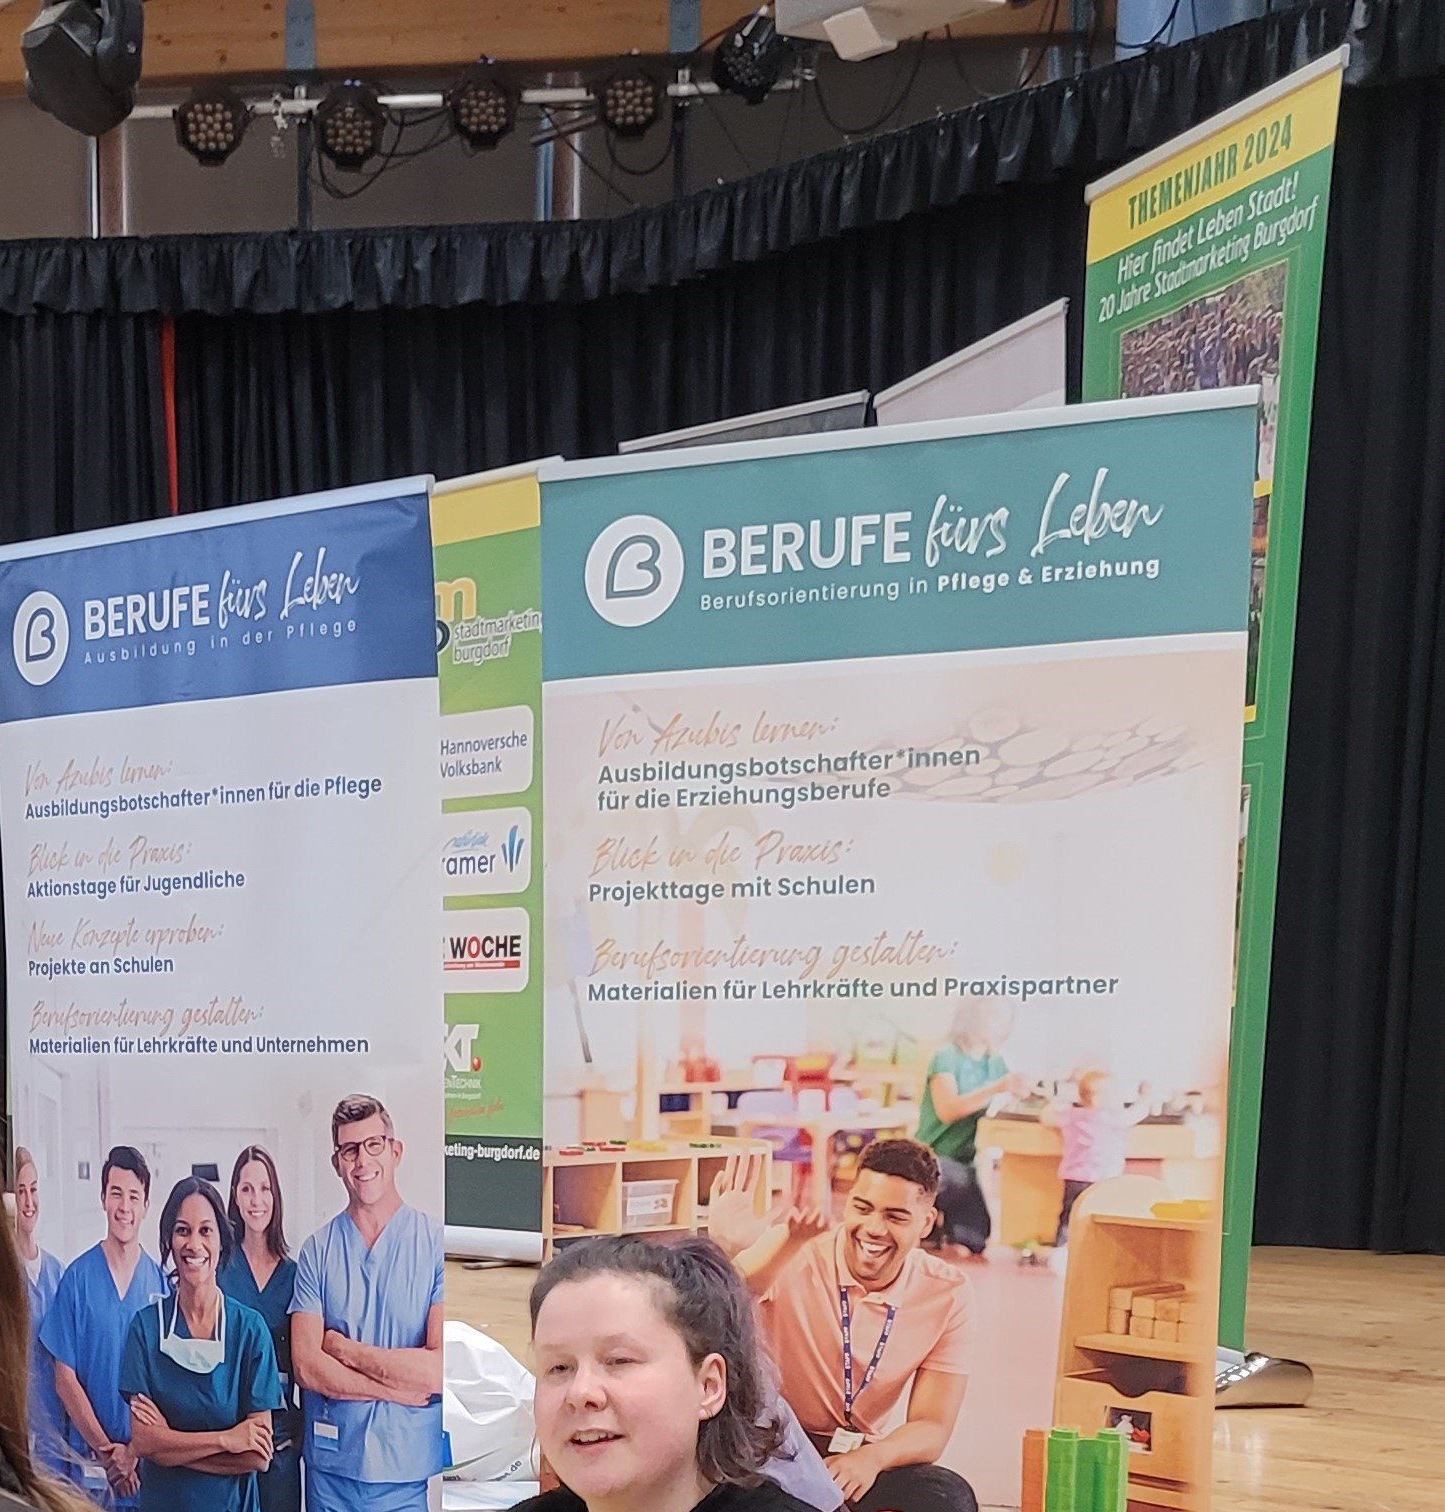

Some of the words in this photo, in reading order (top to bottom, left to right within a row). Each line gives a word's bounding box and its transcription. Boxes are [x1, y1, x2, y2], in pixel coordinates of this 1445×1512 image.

[1128, 143, 1238, 230] THEMENJAHR
[1243, 114, 1292, 171] 2024
[1117, 251, 1149, 284] Hier
[1150, 226, 1194, 274] findet
[1197, 205, 1244, 245] Leben
[1247, 170, 1299, 220] Stadt!
[1099, 296, 1114, 323] 20
[1117, 283, 1151, 316] Jahre
[1154, 233, 1252, 298] Stadtmarketing
[1253, 195, 1319, 251] Burgdorf
[703, 511, 911, 579] BERUFE
[924, 494, 1009, 569] fürs
[1031, 468, 1163, 558] Leben
[84, 584, 210, 641] BERUFE
[219, 570, 268, 629] fürs
[280, 546, 361, 621] Leben
[700, 577, 900, 611] Berufsorientierung
[908, 576, 929, 594] in
[937, 568, 1010, 596] Pflege
[1018, 567, 1034, 586] &
[1041, 556, 1160, 584] Erziehung
[454, 609, 542, 640] stadtmarketin
[84, 638, 197, 665] Ausbildung
[211, 633, 228, 649] in
[242, 628, 274, 646] der
[286, 618, 357, 639] Pflege
[454, 638, 510, 664] burgdorf
[440, 730, 528, 756] Hannoversche
[598, 714, 644, 758] Von
[651, 711, 742, 755] Azubis
[440, 756, 502, 778] Volksbank
[268, 780, 290, 801] für
[294, 778, 321, 798] die
[324, 776, 383, 801] Pflege
[598, 790, 629, 811] für
[635, 786, 670, 808] die
[676, 778, 891, 810] Erziehungsberufe
[442, 854, 496, 875] amer
[589, 835, 658, 878] Blick
[668, 850, 696, 868] in
[705, 831, 742, 875] die
[27, 877, 116, 899] Aktionstage
[119, 875, 141, 893] für
[143, 869, 245, 896] Jugendliche
[589, 880, 725, 906] Projekttage
[731, 876, 772, 899] mit
[778, 875, 875, 898] Schulen
[450, 935, 521, 958] WOCHE
[588, 933, 822, 979] Berufsorientierung
[29, 958, 87, 980] Projekte
[89, 961, 110, 974] an
[113, 956, 174, 974] Schulen
[588, 981, 718, 1001] Materialien
[723, 979, 757, 1000] für
[762, 978, 884, 1000] Lehrkräfte
[890, 977, 936, 998] und
[944, 975, 1119, 1001] Praxispartner
[29, 1036, 111, 1054] Materialien
[113, 1036, 135, 1053] für
[137, 1036, 218, 1053] Lehrkräfte
[221, 1036, 253, 1053] und
[256, 1035, 370, 1054] Unternehmen
[444, 1143, 541, 1162] keting-burgdorf.de
